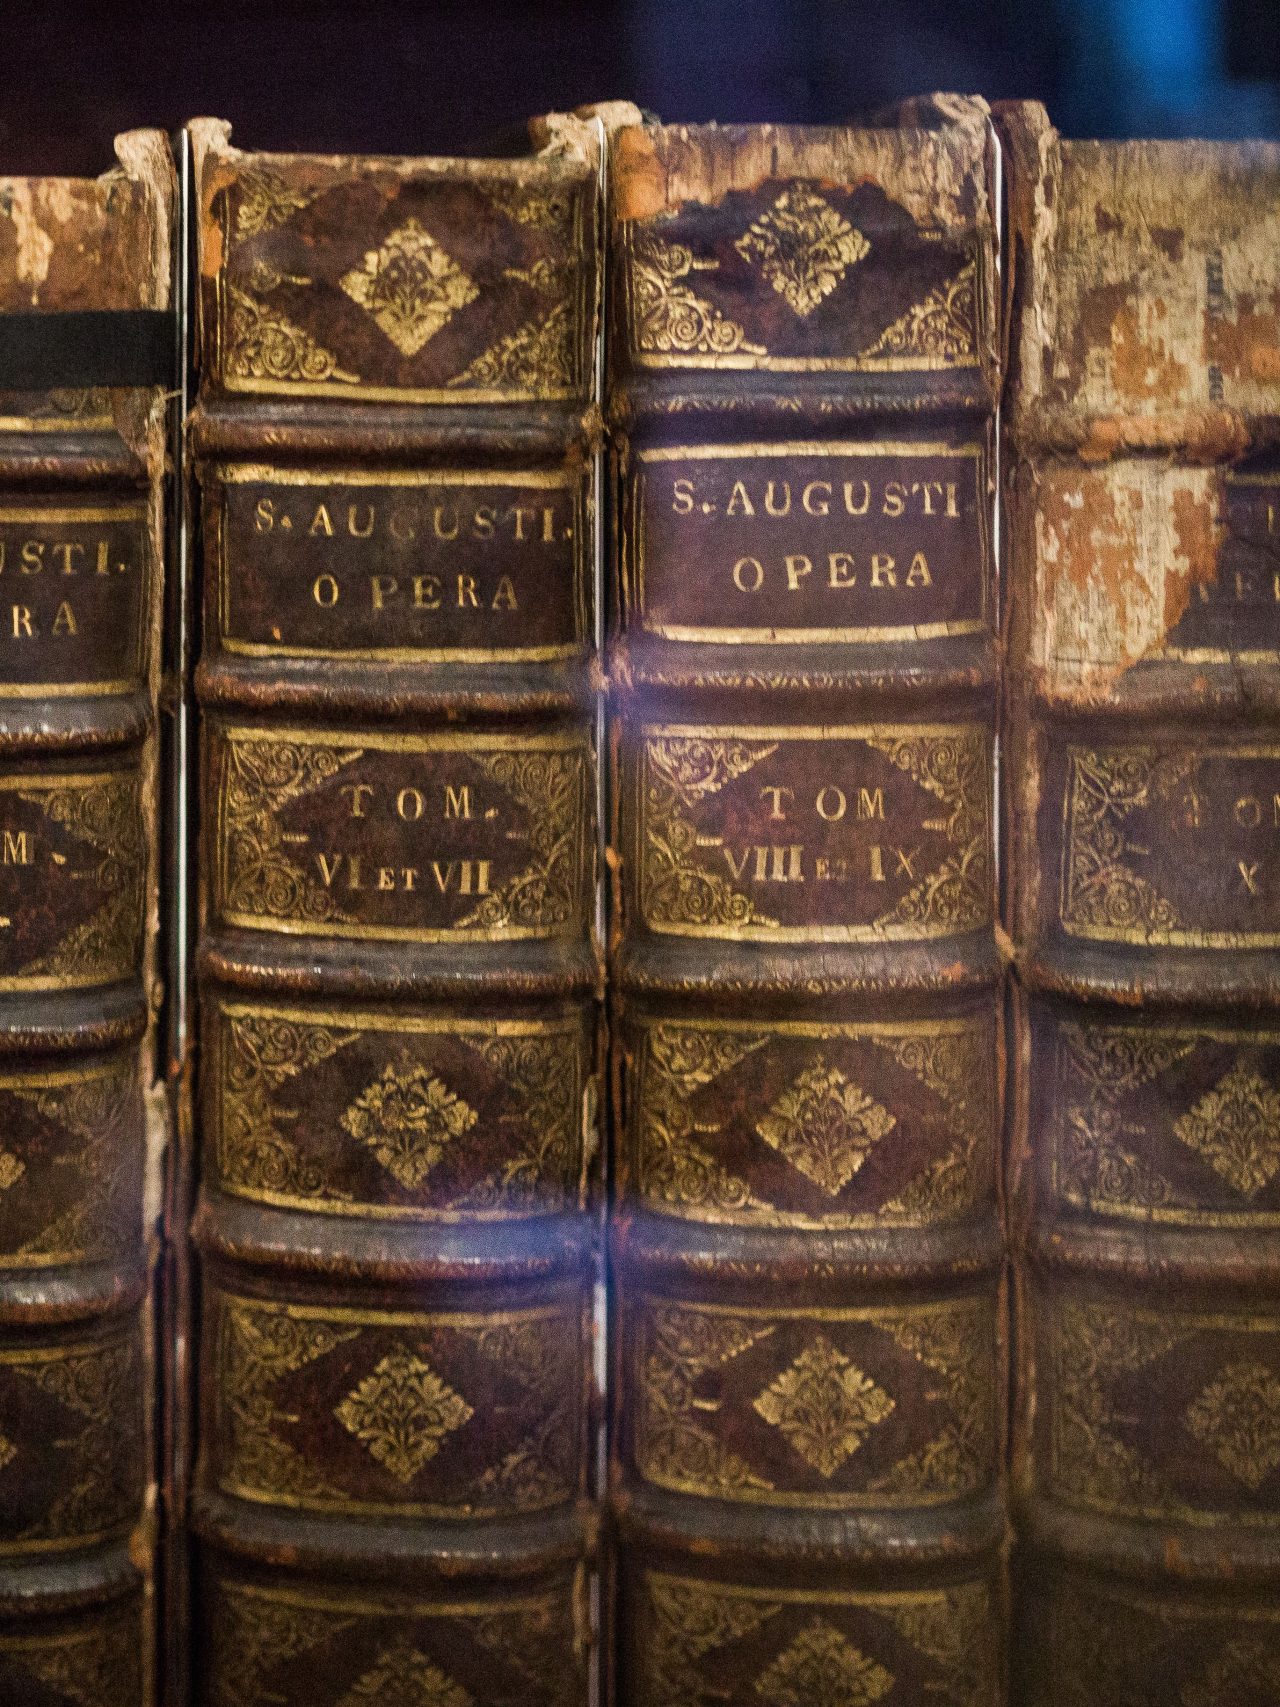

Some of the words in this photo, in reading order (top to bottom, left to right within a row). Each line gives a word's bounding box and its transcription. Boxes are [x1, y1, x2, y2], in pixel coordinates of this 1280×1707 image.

[732, 552, 933, 592] OPERA
[312, 574, 519, 611] OPERA
[760, 785, 886, 823] TOM
[318, 852, 364, 891] VI
[378, 865, 418, 892] ET
[431, 859, 495, 896] VII
[723, 845, 805, 883] VIII
[869, 844, 921, 883] IX
